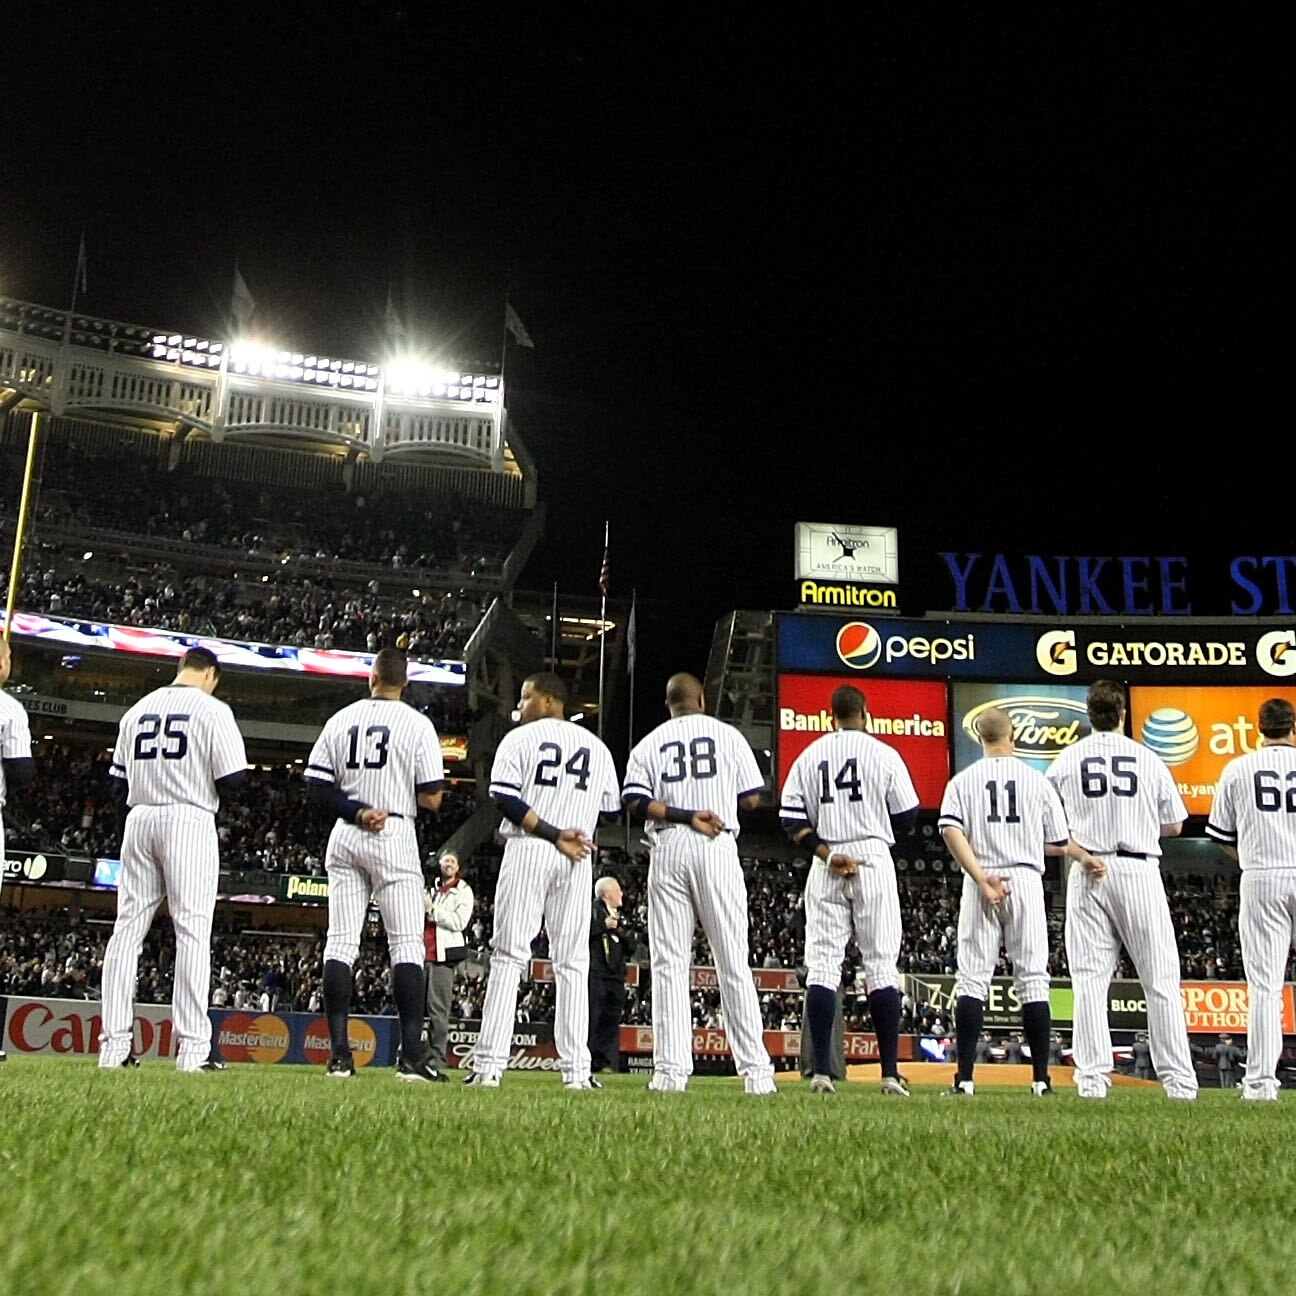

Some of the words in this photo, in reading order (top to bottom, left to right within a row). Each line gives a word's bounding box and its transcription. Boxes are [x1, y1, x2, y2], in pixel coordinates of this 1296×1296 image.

[801, 581, 897, 608] Armitron
[938, 552, 1192, 616] YANKEE
[886, 634, 975, 665] pepsi
[1087, 641, 1247, 666] GATORADE
[42, 701, 68, 714] CLUB
[780, 708, 835, 732] Bank
[133, 713, 190, 761] 25
[1007, 708, 1081, 746] Ford
[345, 724, 391, 770] 13
[659, 736, 718, 783] 38
[534, 742, 592, 791] 24
[817, 758, 863, 804] 14
[1080, 756, 1138, 798] 65
[985, 780, 1021, 823] 11
[287, 876, 329, 899] Polan
[929, 983, 1023, 1012] ZES
[1111, 999, 1148, 1012] BLOC
[218, 1030, 289, 1048] MasterCard
[851, 1037, 879, 1055] Far
